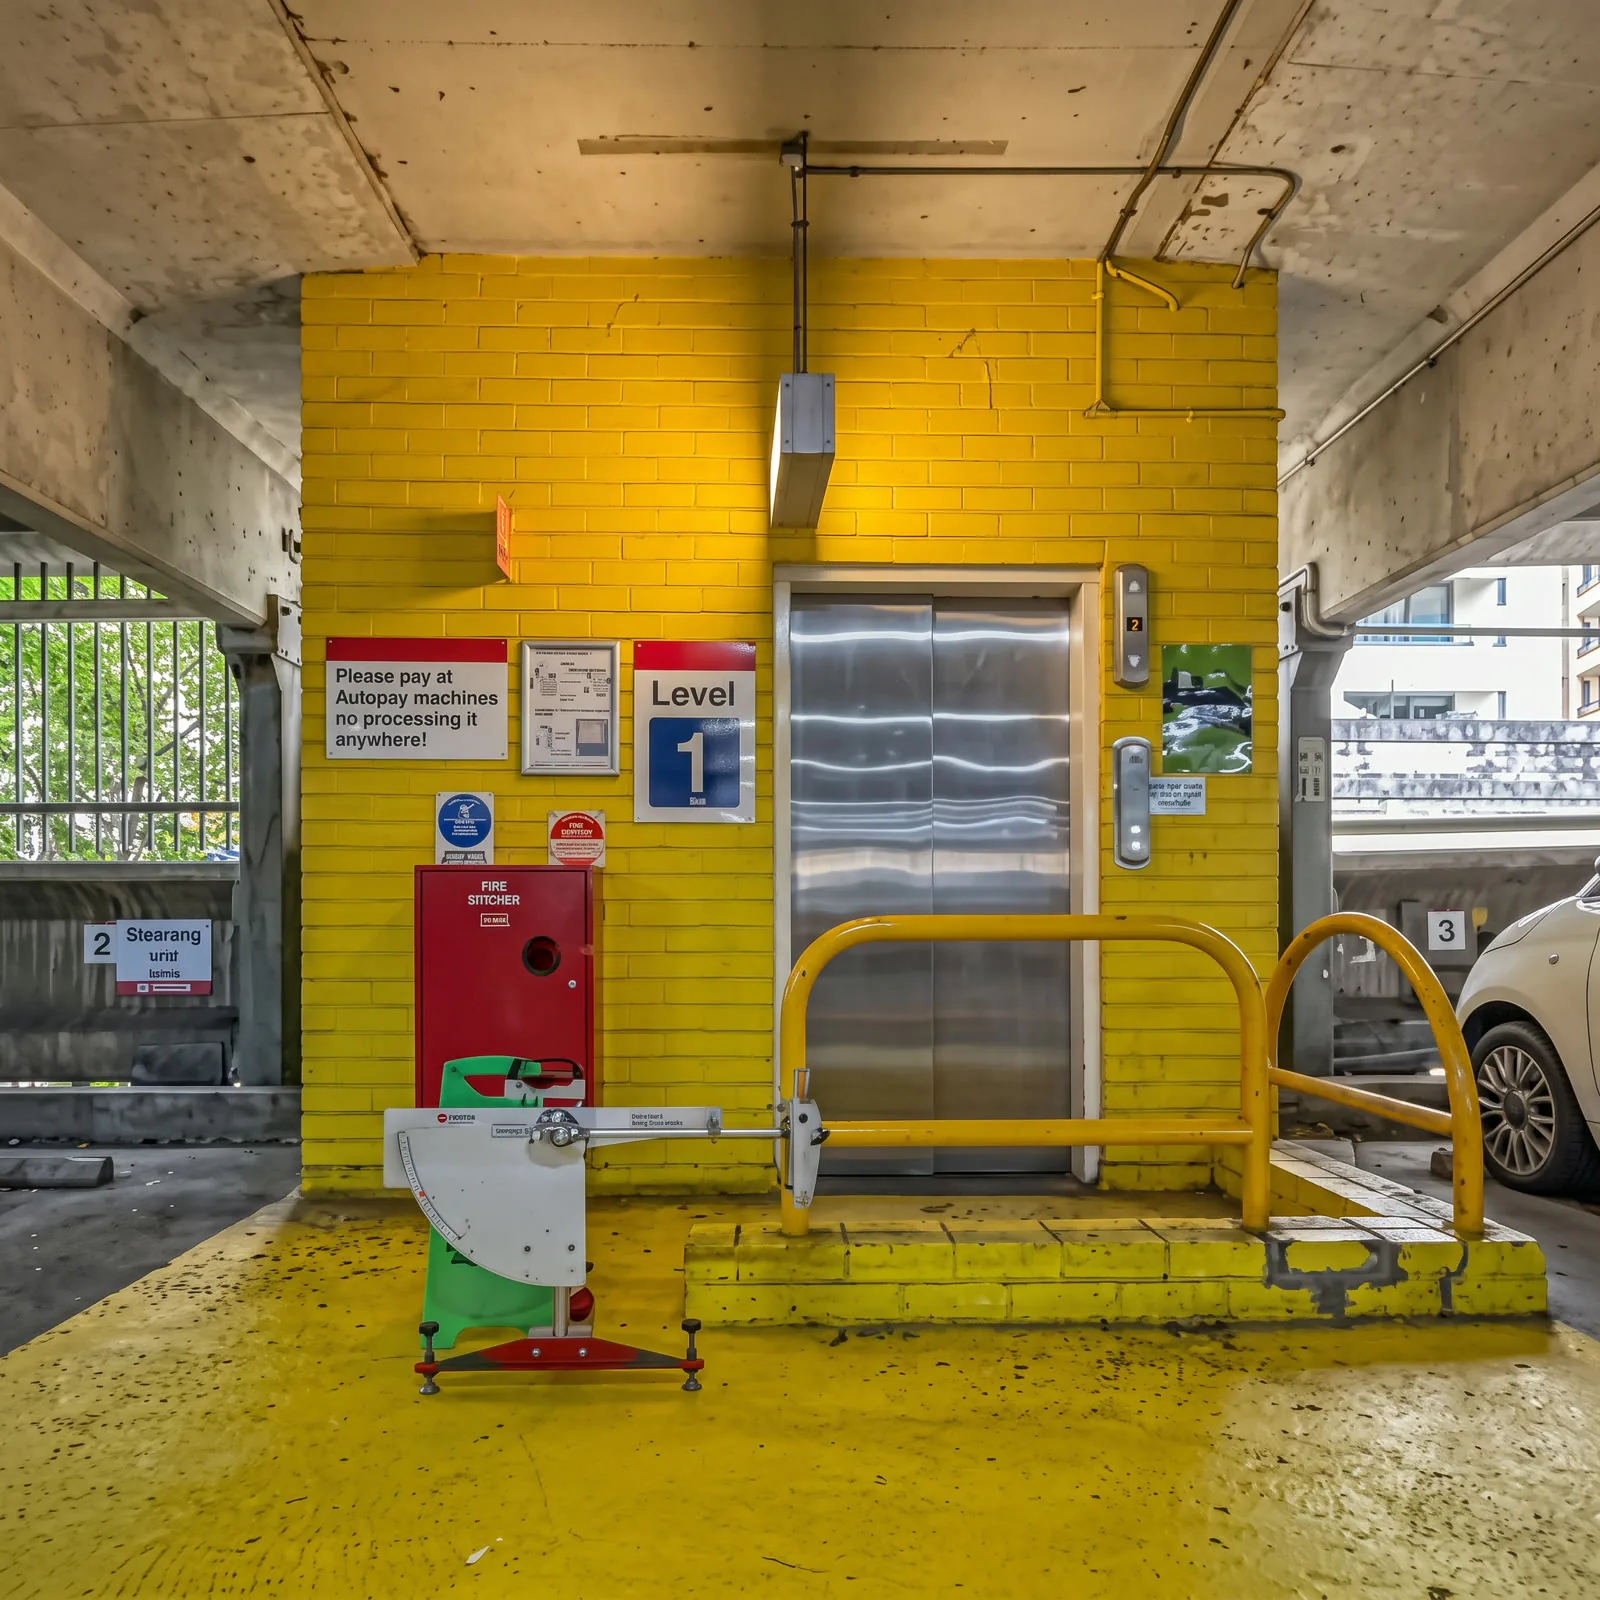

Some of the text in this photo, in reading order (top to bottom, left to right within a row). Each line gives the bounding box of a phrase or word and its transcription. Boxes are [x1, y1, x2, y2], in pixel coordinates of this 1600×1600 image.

[1131, 619, 1139, 631] 2
[336, 668, 453, 687] Please pay at
[335, 689, 499, 709] Autopay machines
[652, 680, 735, 707] Level
[336, 711, 478, 730] no processing it
[335, 732, 427, 750] anywhere!
[677, 732, 704, 793] 1
[481, 881, 507, 892] FIRE
[467, 894, 520, 906] STITCHER
[126, 927, 201, 946] Stearang
[1438, 919, 1456, 943] 3
[93, 932, 111, 956] 2
